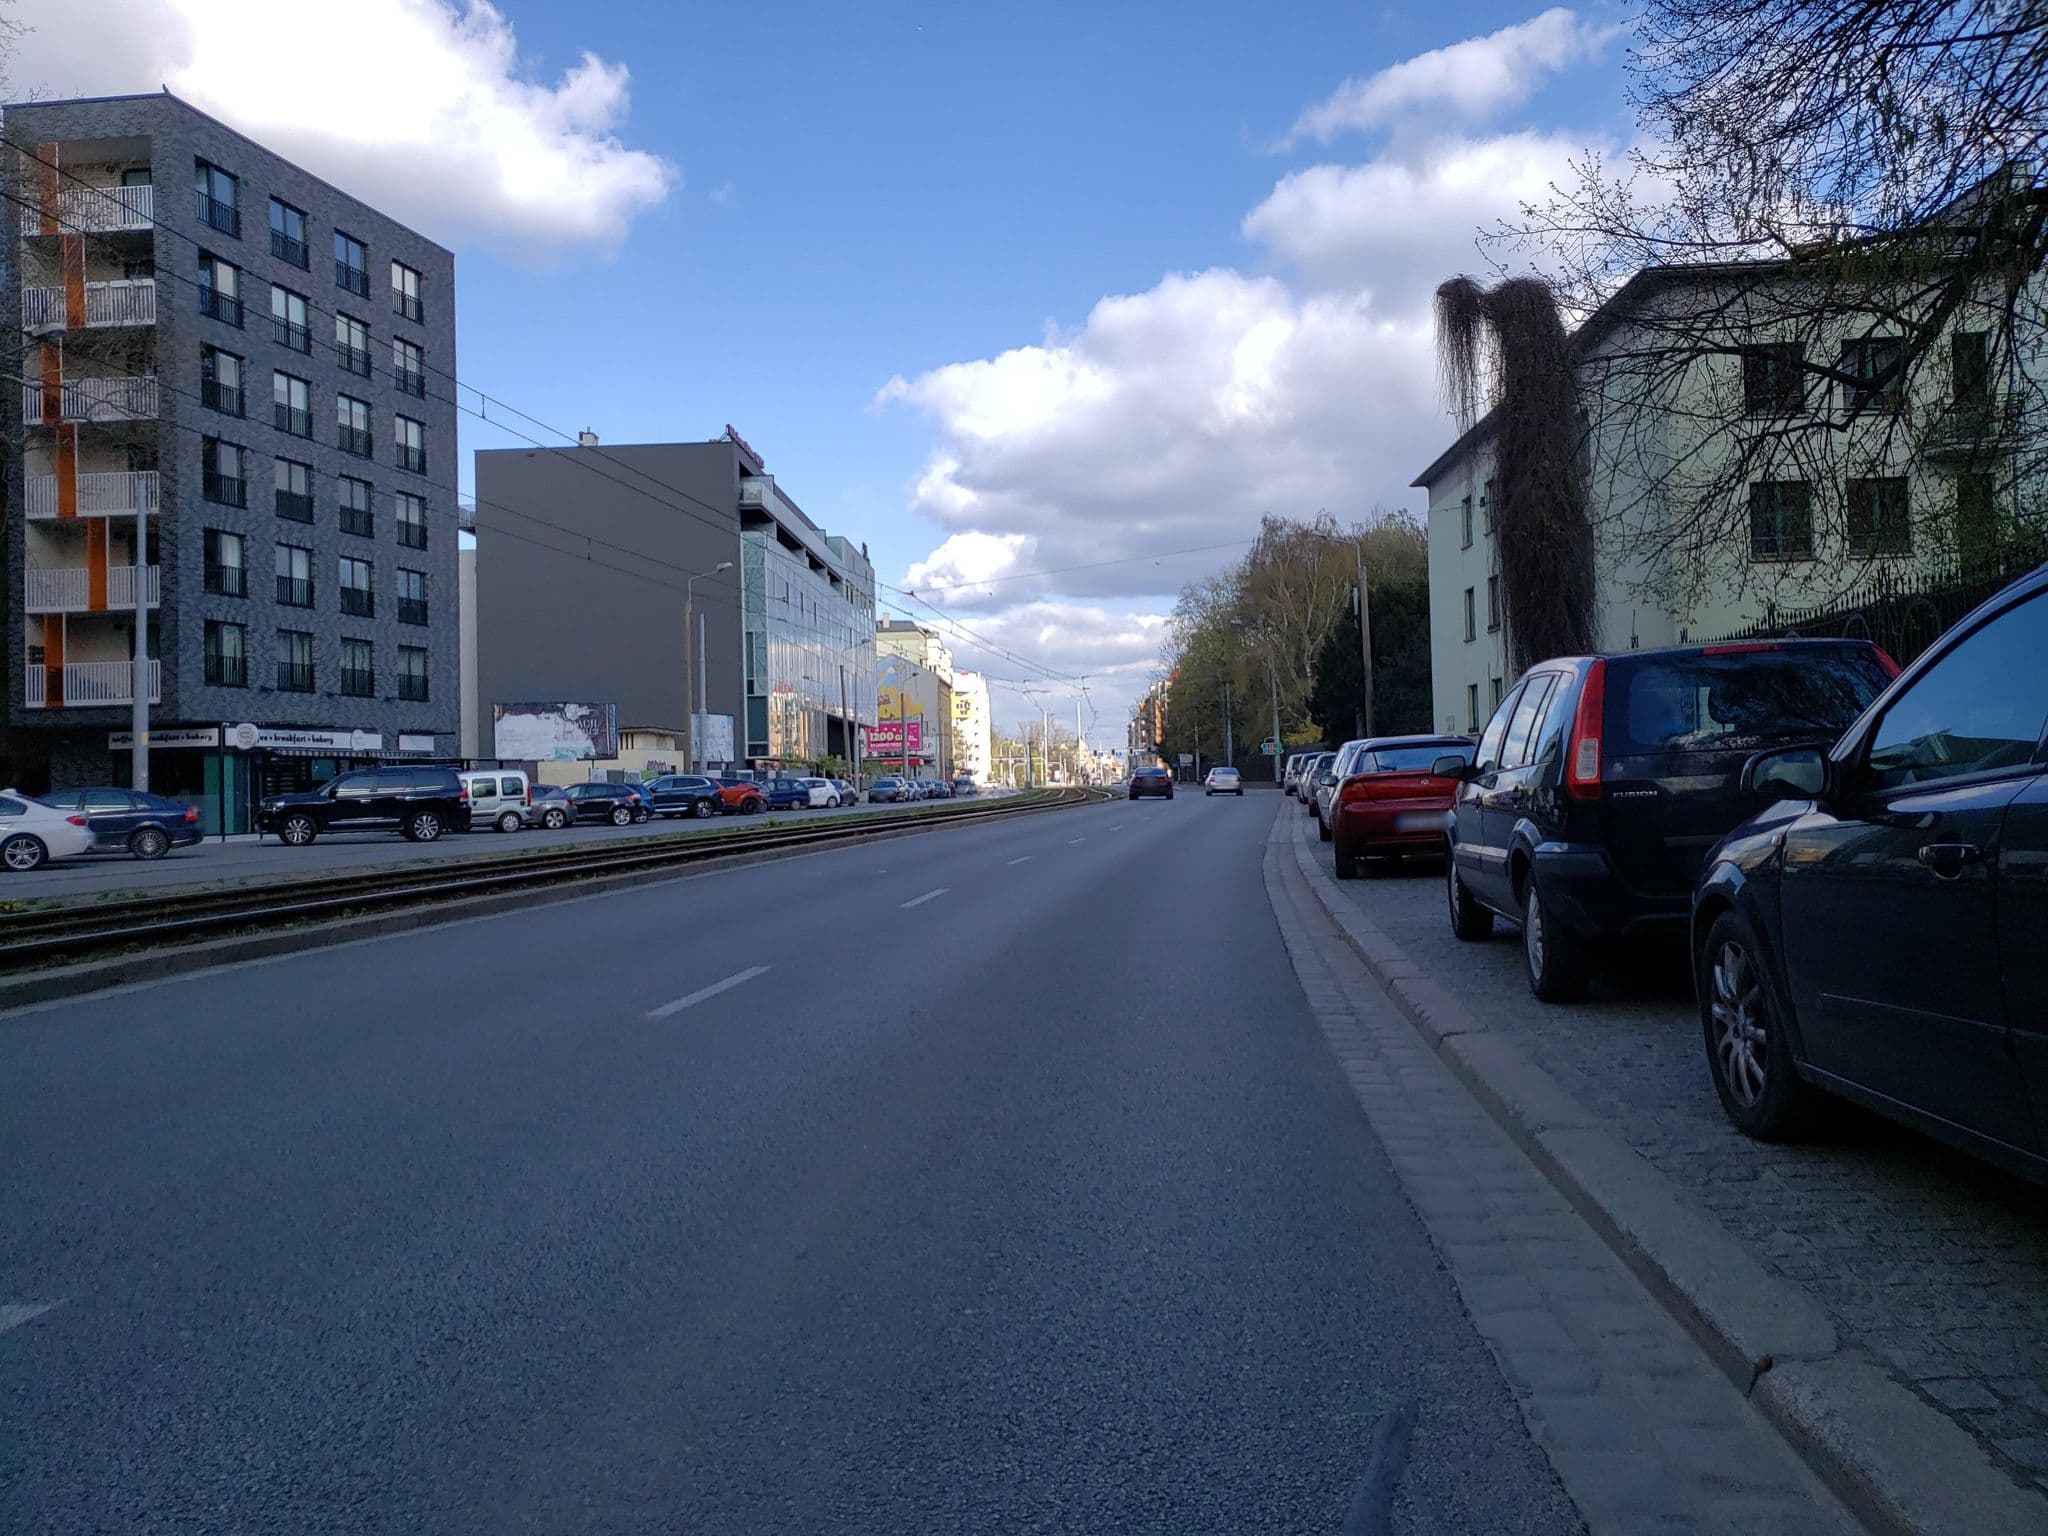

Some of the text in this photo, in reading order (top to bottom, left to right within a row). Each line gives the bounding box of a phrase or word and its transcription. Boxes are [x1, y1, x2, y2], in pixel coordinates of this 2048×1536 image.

[186, 732, 212, 741] bakery
[274, 733, 306, 744] breakfast
[312, 734, 334, 746] bakery
[869, 732, 894, 742] 1200
